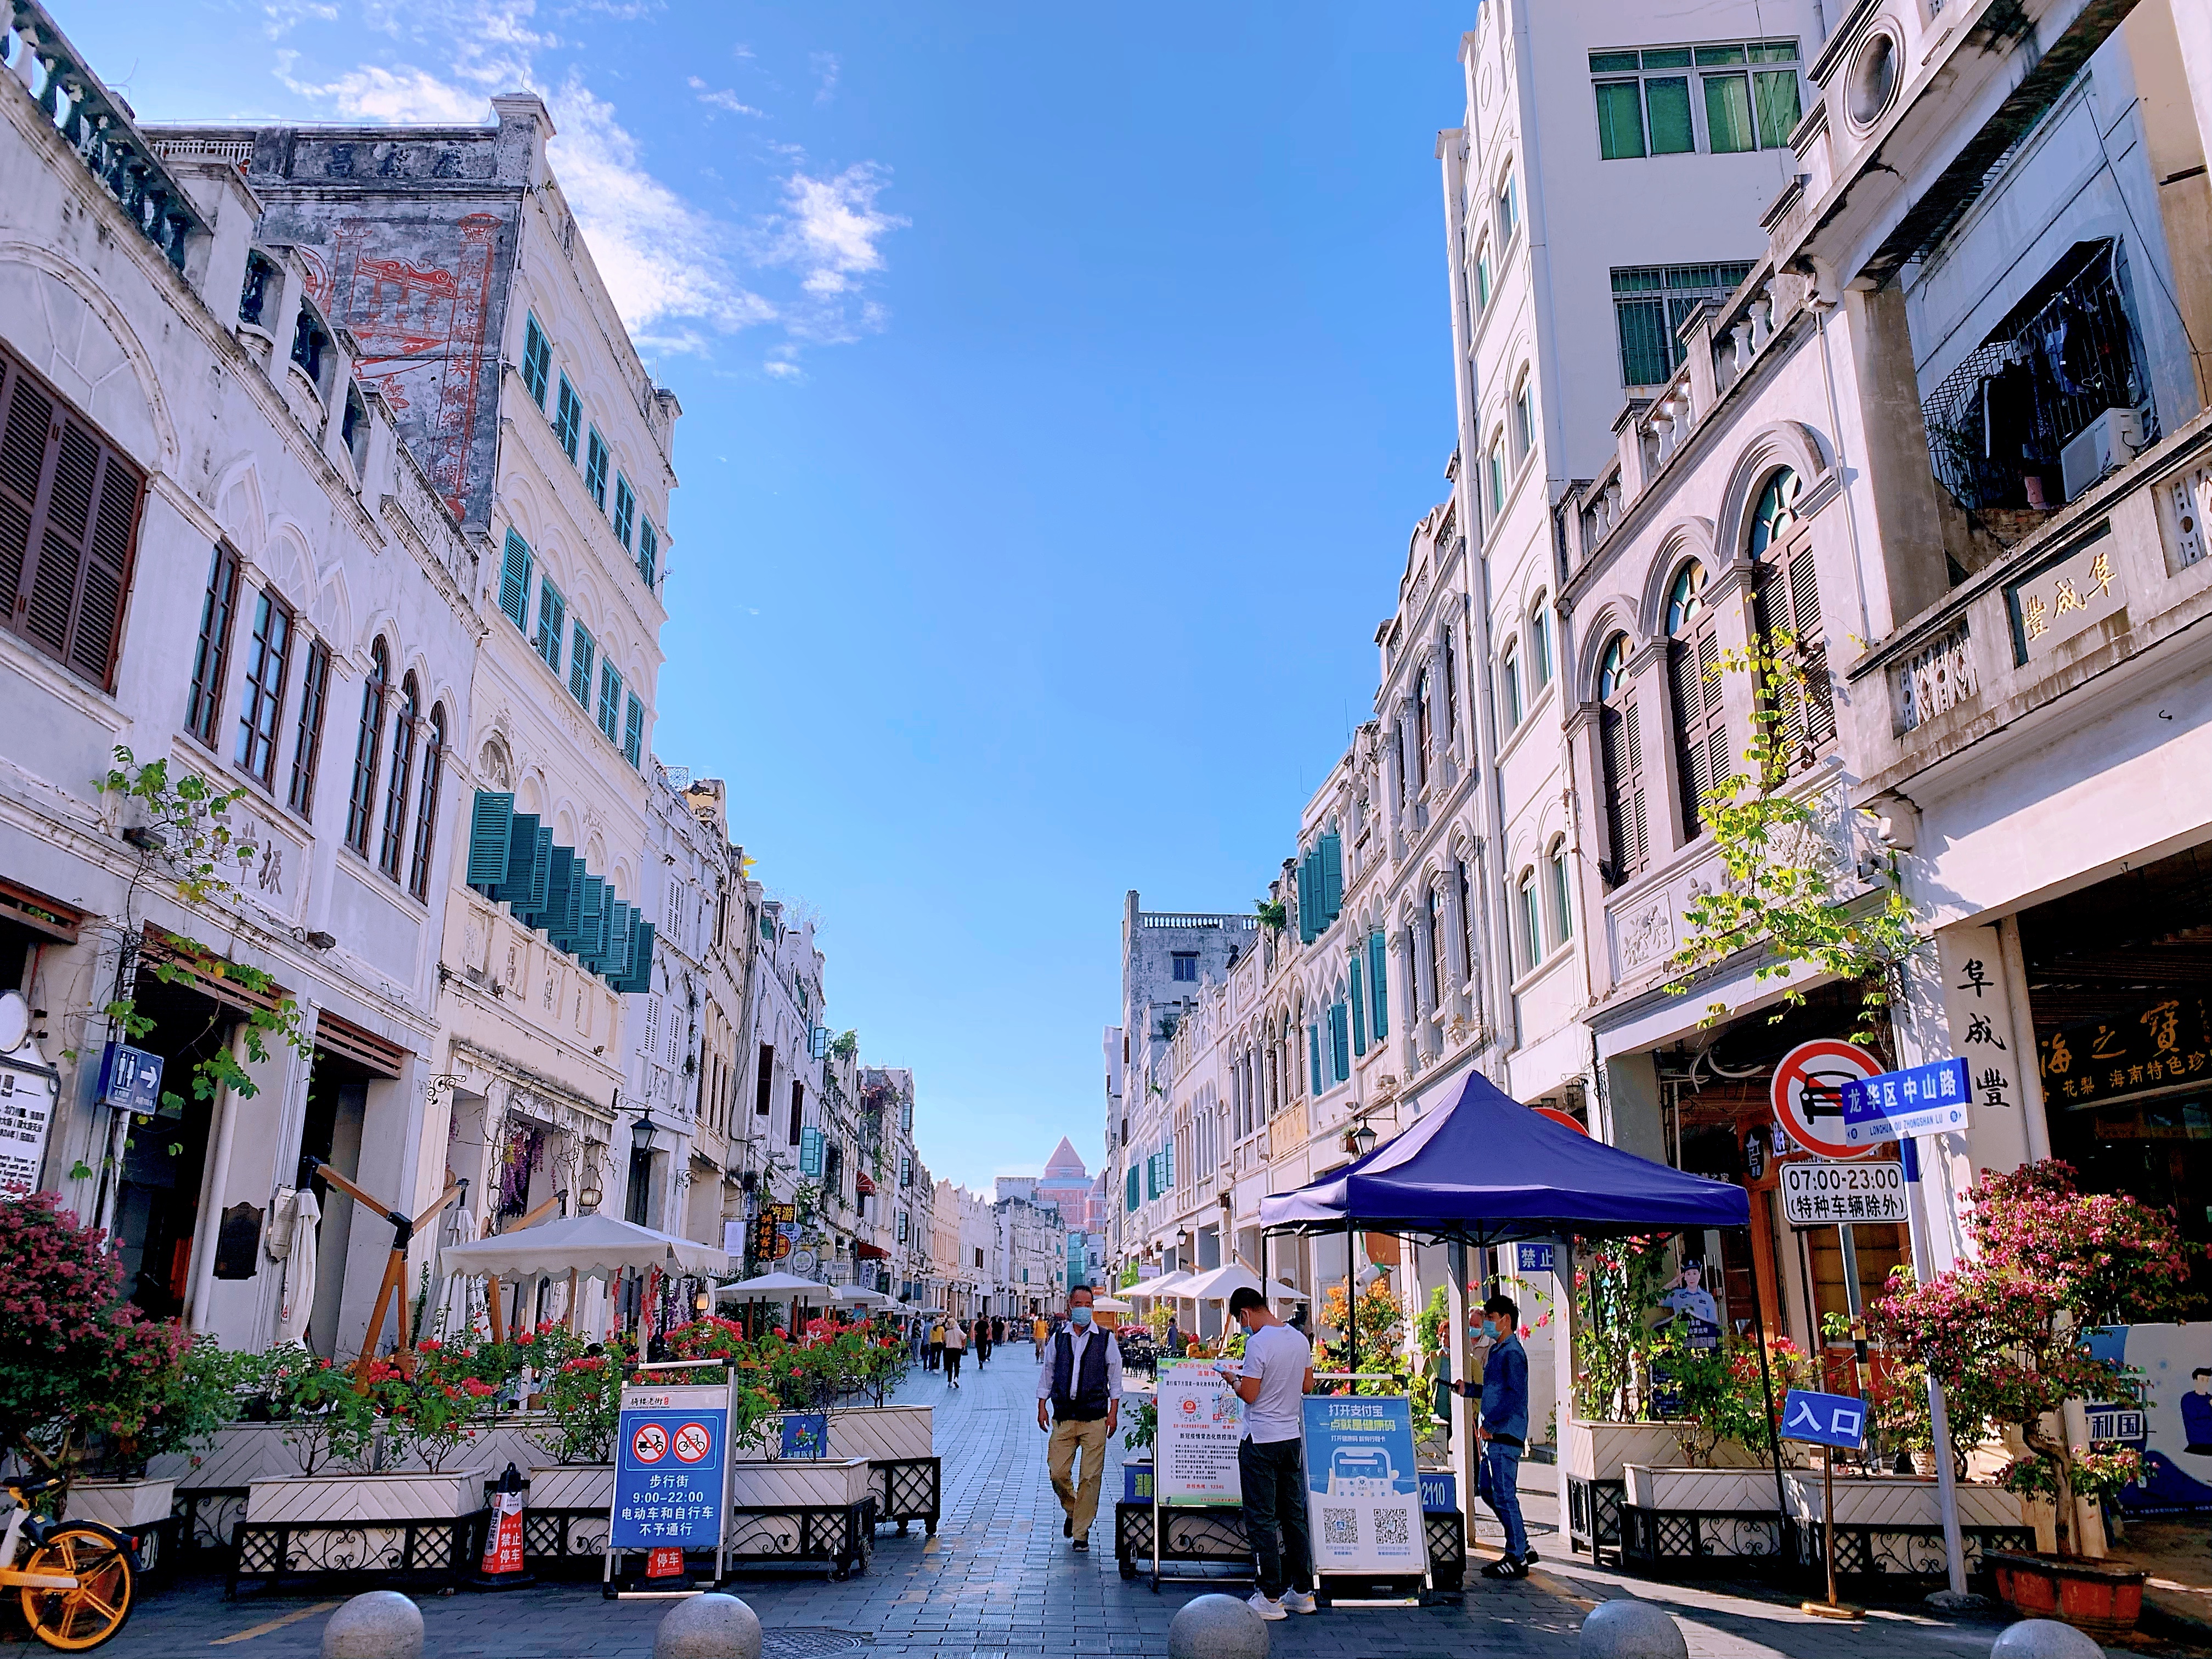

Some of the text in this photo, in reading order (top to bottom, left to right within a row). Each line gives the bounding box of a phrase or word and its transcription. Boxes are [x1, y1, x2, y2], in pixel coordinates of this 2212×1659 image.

[2110, 1051, 2212, 1088] 海南特色珍
[1848, 1068, 1956, 1114] 龙华区中山路
[1870, 1123, 1893, 1136] LONGHUA
[1904, 1115, 1933, 1130] ZHONGSHAN
[1936, 1113, 1943, 1124] LU
[1789, 1169, 1898, 1190] 07:00-23:00
[1521, 1248, 1554, 1268] 禁止
[1328, 1404, 1384, 1418] 打开支付宝
[1788, 1401, 1861, 1437] 入口
[1319, 1419, 1396, 1432] 一点就是健康码
[1180, 1432, 1237, 1441] 新冠疫情常态化防控须知
[649, 1474, 689, 1489] 步行街
[1421, 1482, 1446, 1505] 2110
[622, 1506, 714, 1521] 电动车和自行车
[639, 1522, 693, 1537] 不予通行
[501, 1532, 521, 1547] 禁止
[500, 1548, 520, 1564] 停车
[657, 1551, 679, 1568] 停车
